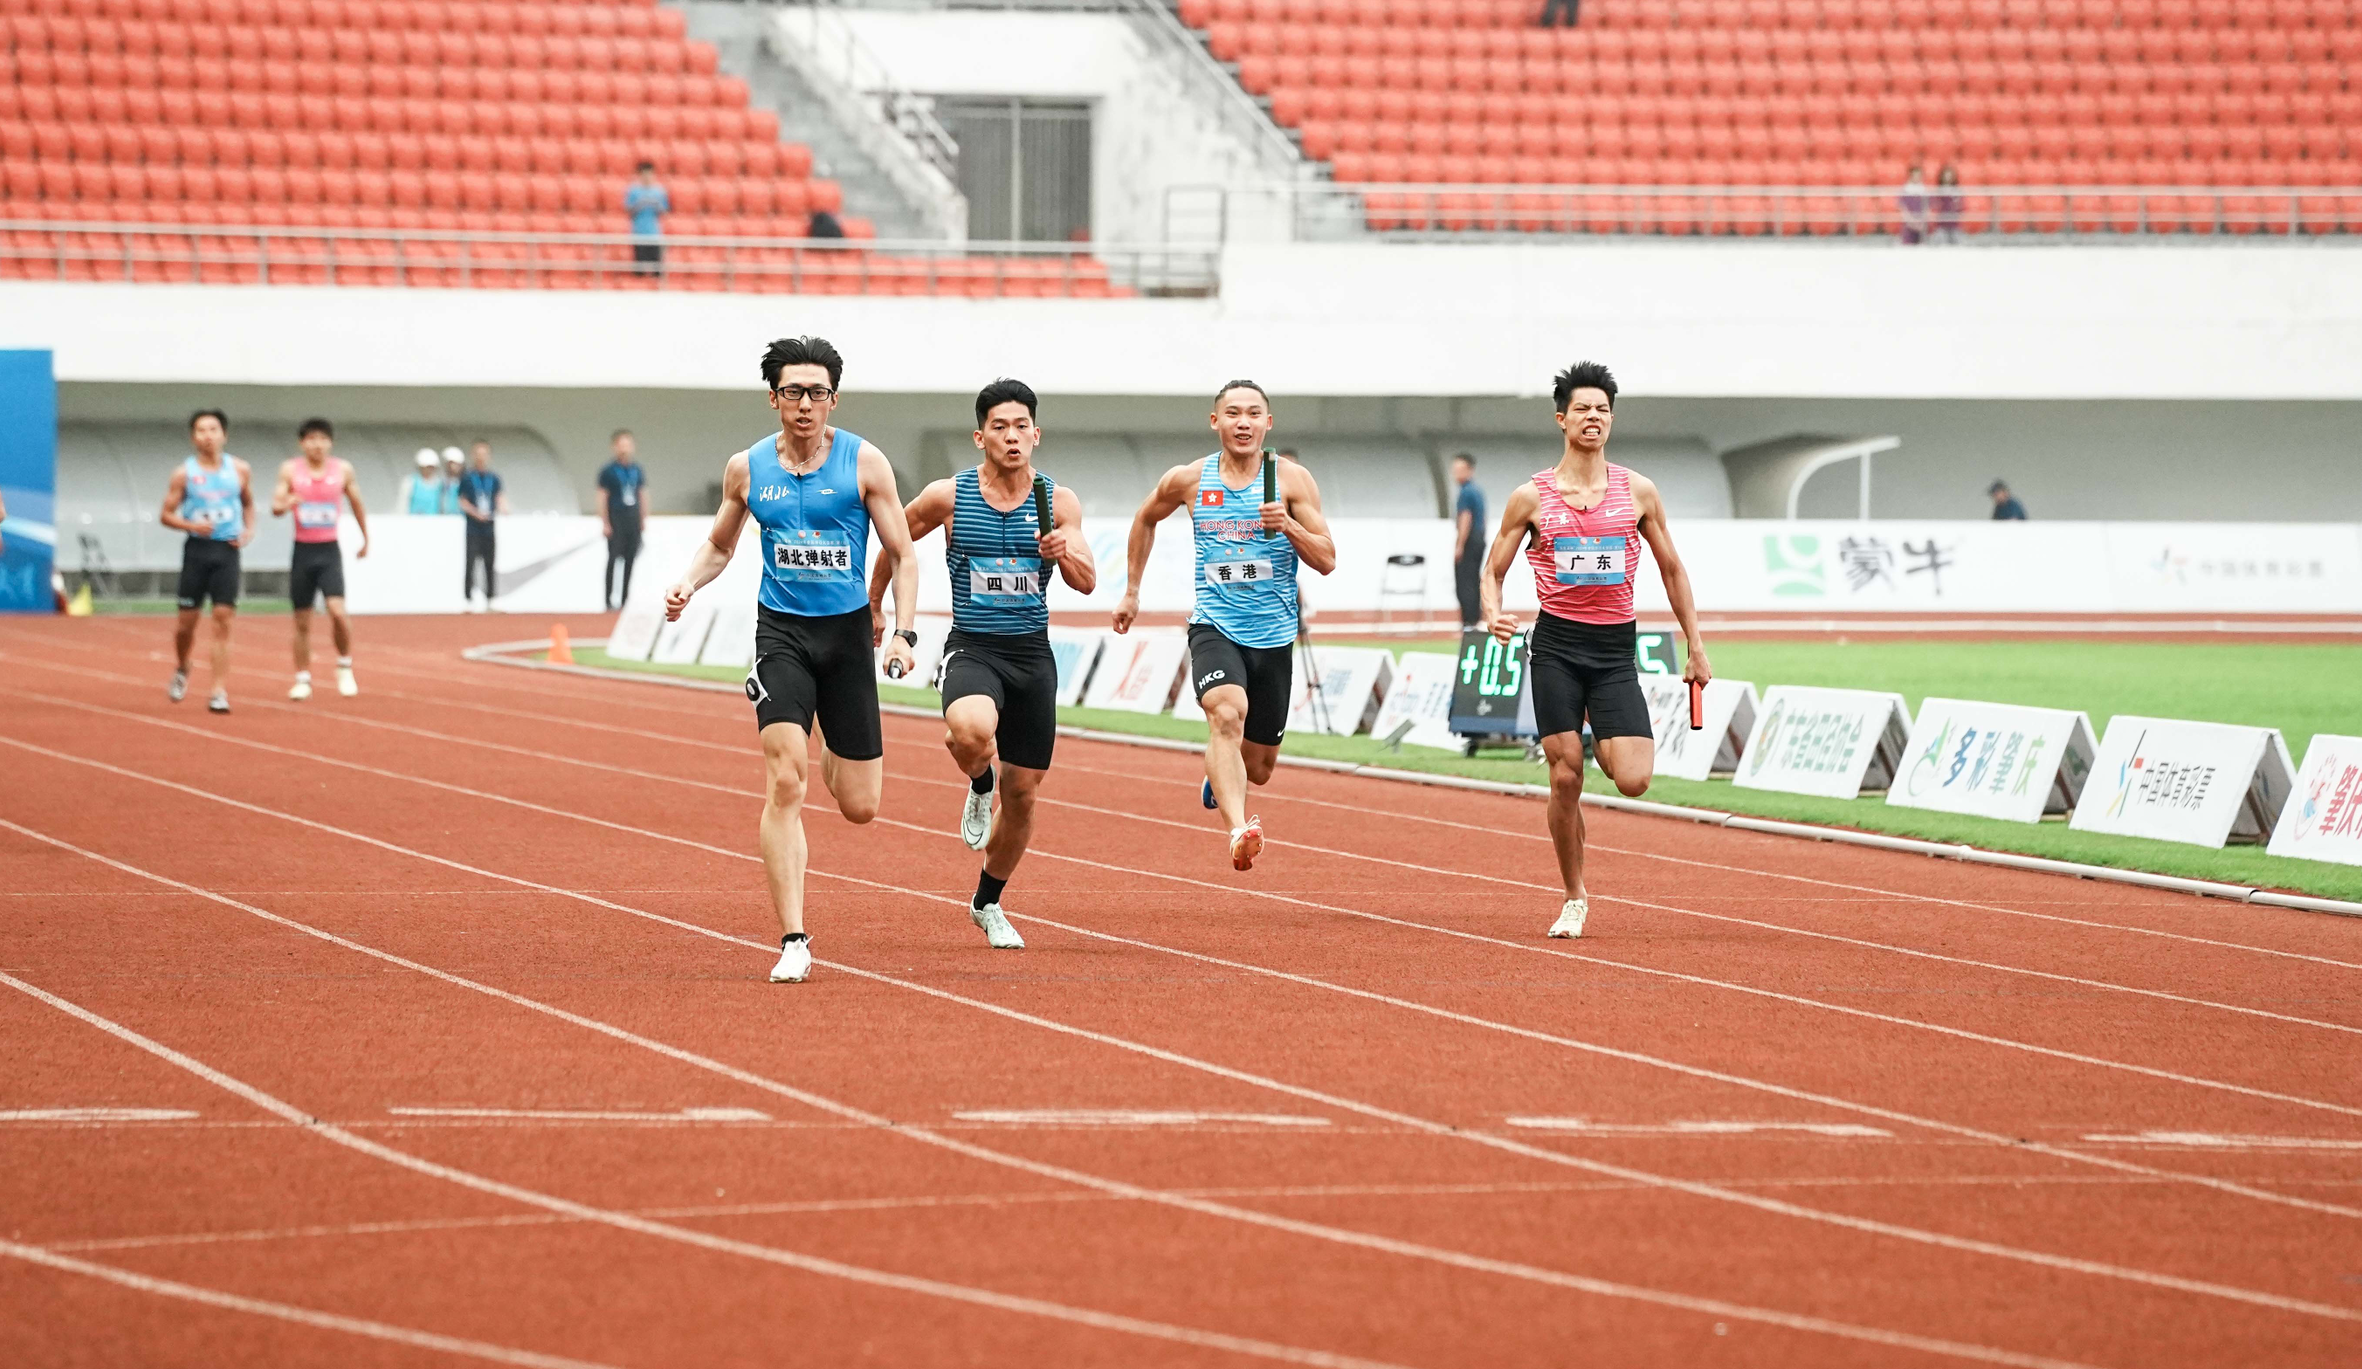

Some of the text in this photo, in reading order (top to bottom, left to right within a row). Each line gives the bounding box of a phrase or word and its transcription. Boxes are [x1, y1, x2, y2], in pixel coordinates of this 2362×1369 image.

[1200, 520, 1264, 531] HONG KON
[1217, 530, 1256, 541] CHINA
[777, 547, 848, 567] 湖北弹射者
[1570, 554, 1612, 571] 广东
[1839, 535, 1957, 596] 蒙牛
[1218, 563, 1257, 581] 香港
[987, 576, 1028, 592] 四川
[1460, 635, 1525, 697] +0.5
[1198, 669, 1226, 690] HKG
[1942, 726, 2047, 797] 多彩肇庆
[2137, 758, 2216, 811] 中国体育彩票
[2318, 764, 2362, 841] 肇庆
